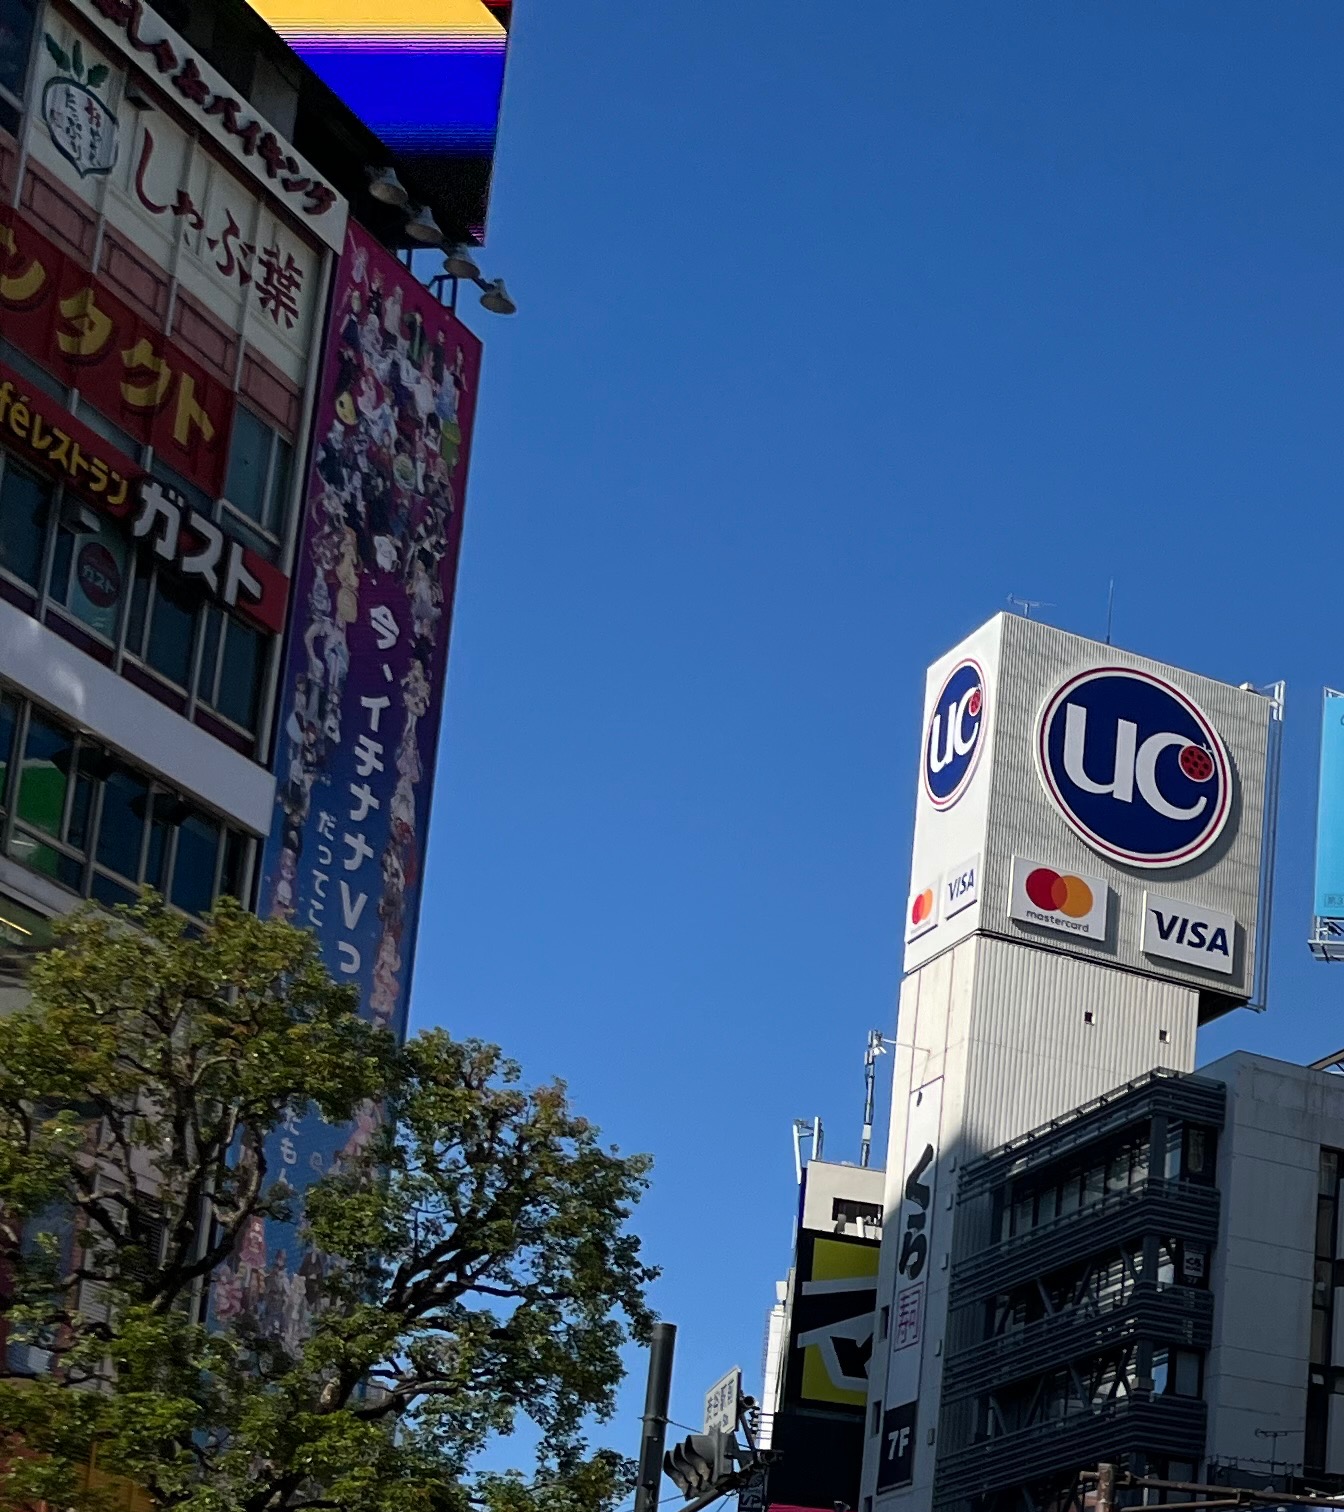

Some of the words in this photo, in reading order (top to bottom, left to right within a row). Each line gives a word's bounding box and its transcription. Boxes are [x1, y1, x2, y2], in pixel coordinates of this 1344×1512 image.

[132, 126, 303, 329] しゃぶ葉
[133, 480, 263, 606] ガスト
[930, 685, 980, 773] UC
[1062, 702, 1208, 821] UC
[947, 867, 975, 902] VISA
[1026, 909, 1090, 934] mastercard
[1150, 908, 1230, 957] VISA
[887, 1426, 911, 1462] 7F
